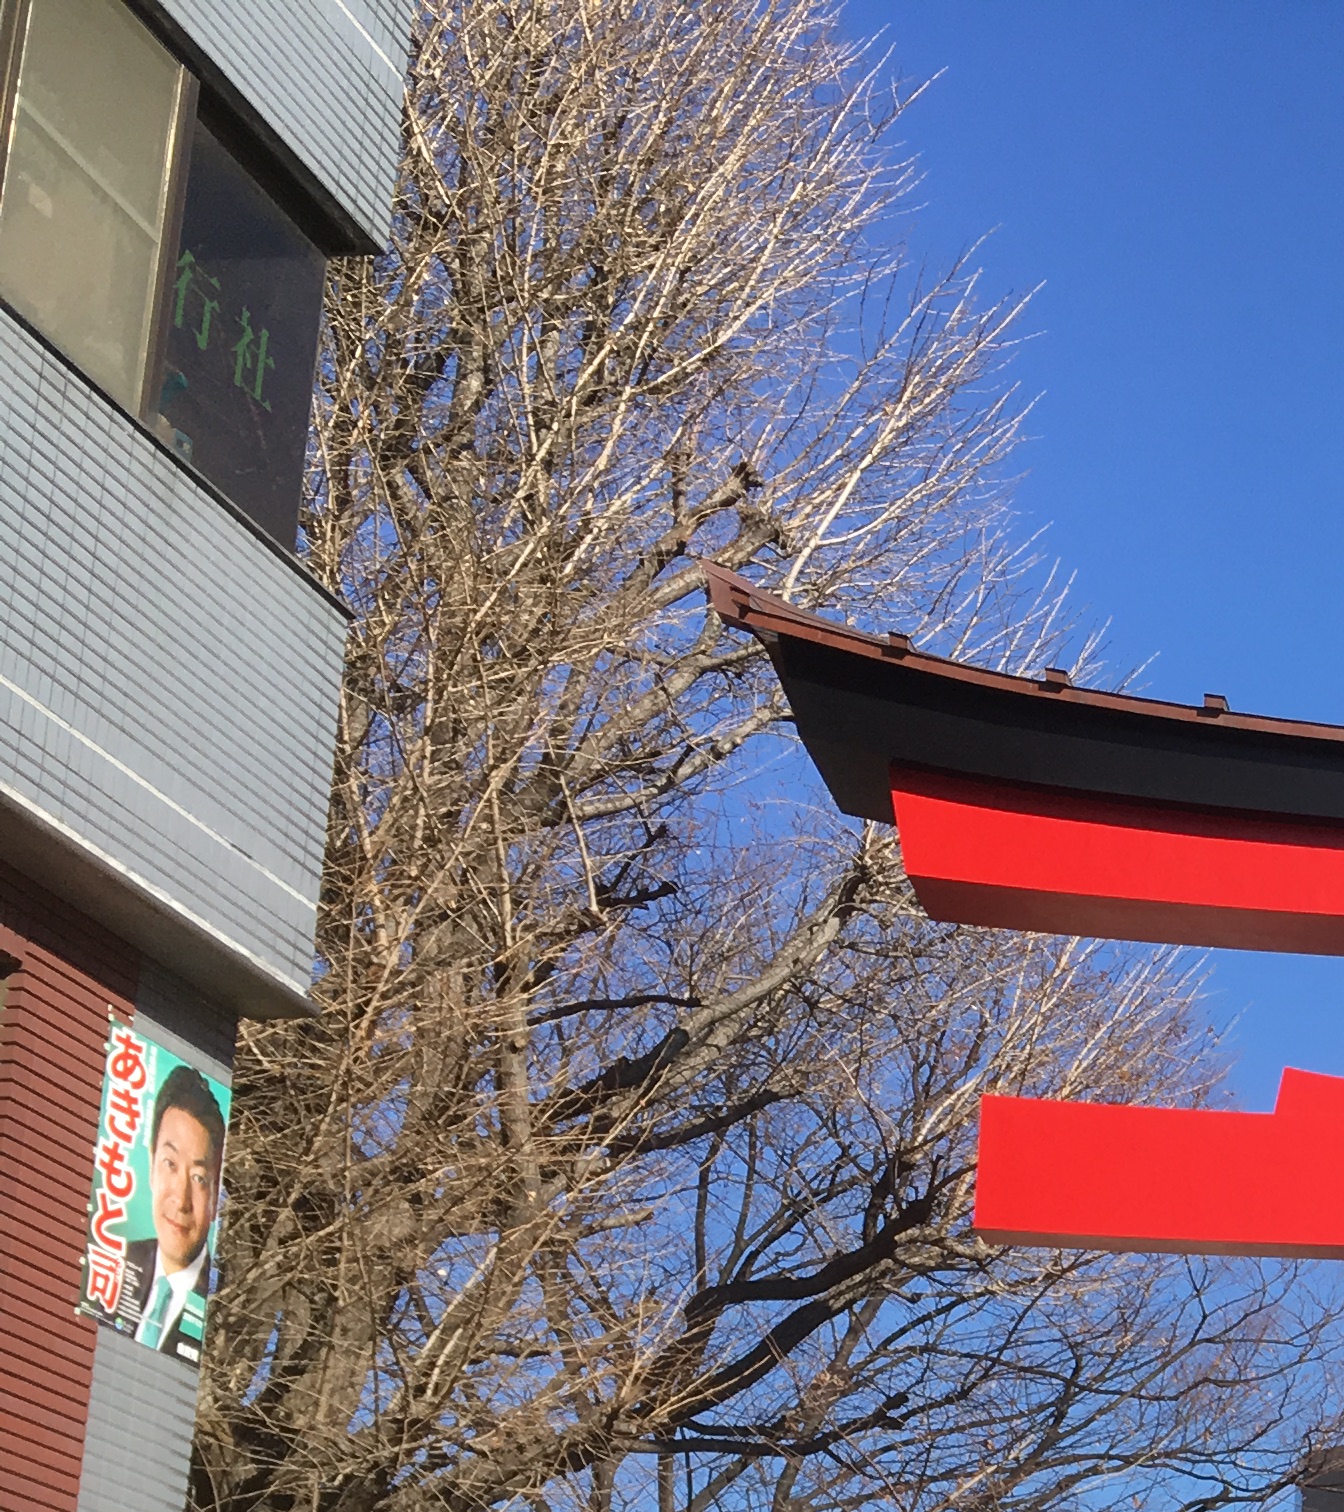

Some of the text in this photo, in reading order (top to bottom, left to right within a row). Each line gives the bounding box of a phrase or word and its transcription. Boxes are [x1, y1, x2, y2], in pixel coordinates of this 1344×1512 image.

[89, 1030, 148, 1311] あきもと司
